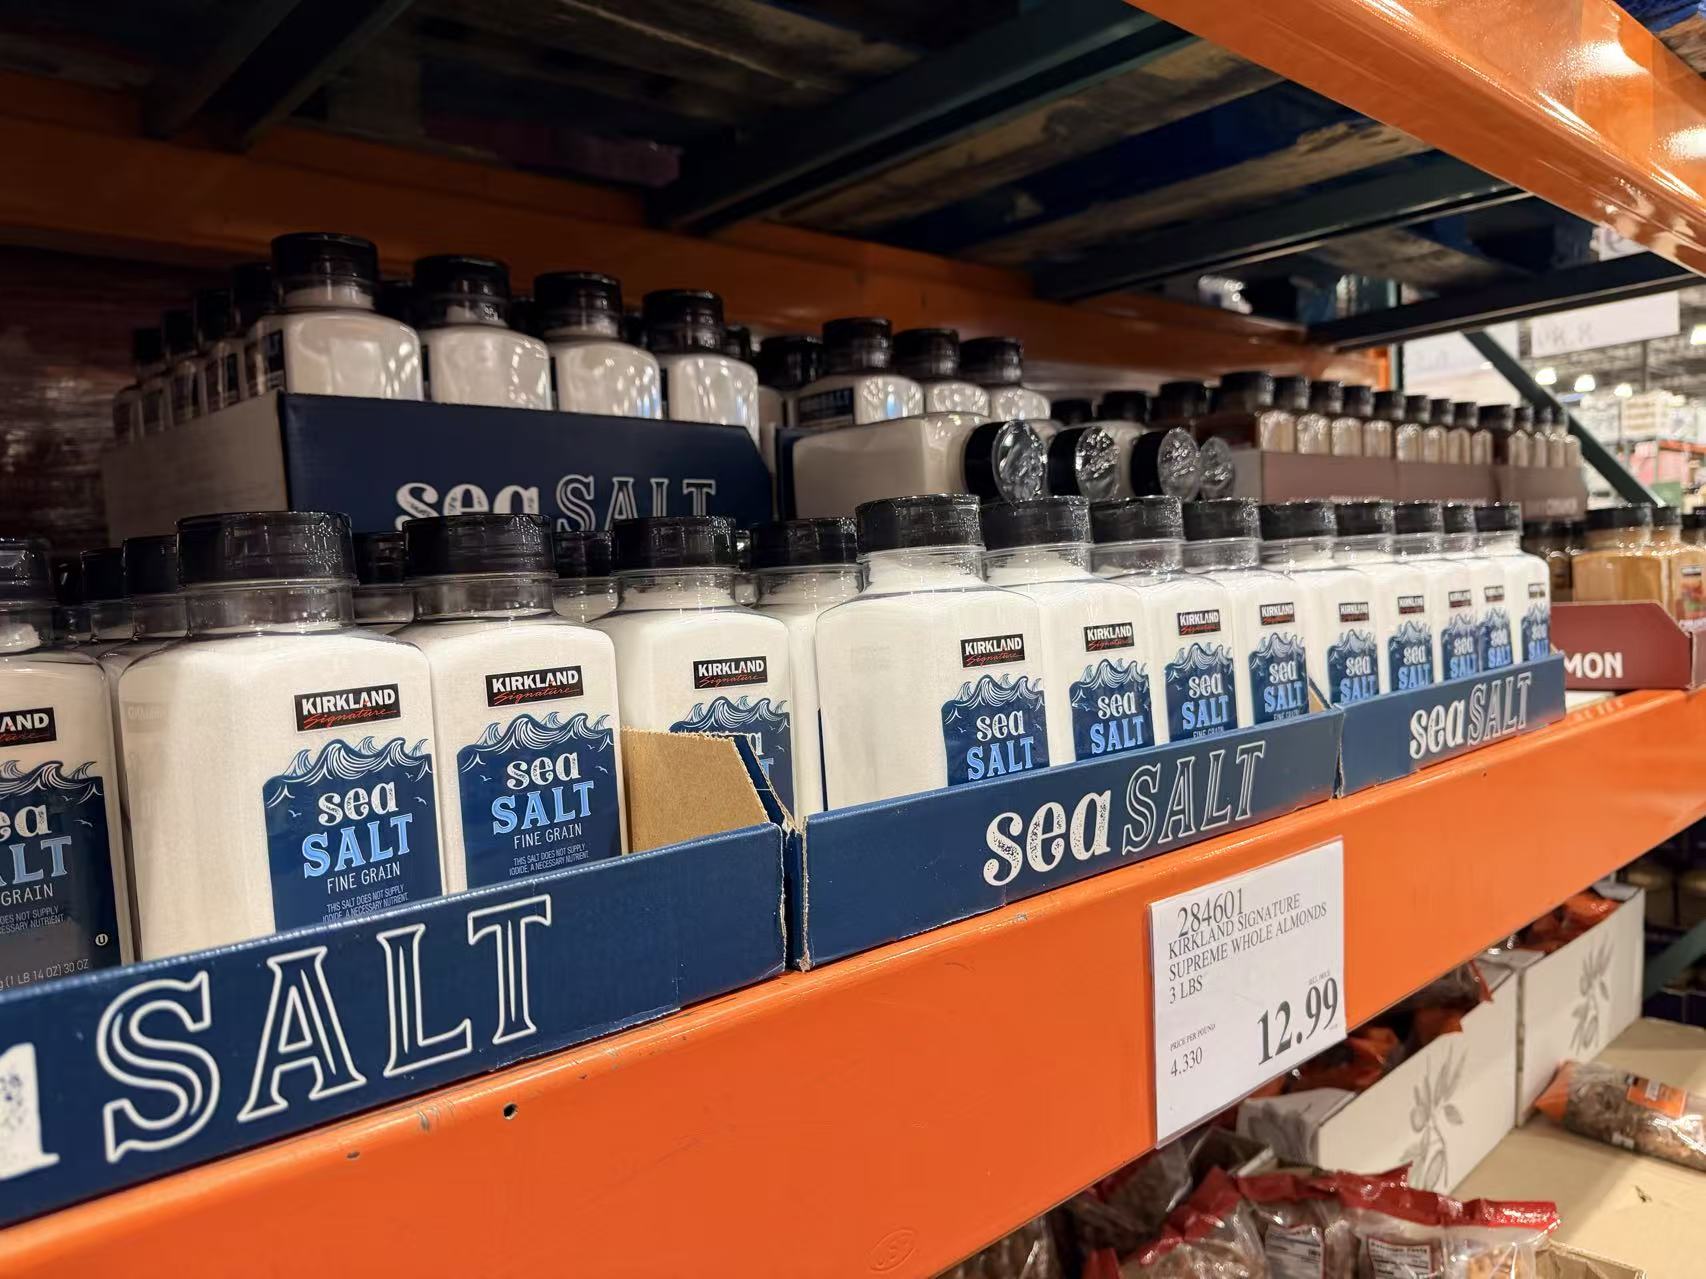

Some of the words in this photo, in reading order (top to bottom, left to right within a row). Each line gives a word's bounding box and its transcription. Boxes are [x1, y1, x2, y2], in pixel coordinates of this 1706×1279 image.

[1179, 611, 1220, 626] KIRKLAND
[1261, 603, 1294, 617] KIRKLAND
[1086, 624, 1133, 641] KIRKLAND
[963, 651, 1023, 667] Signature
[964, 636, 1023, 656] KIRKLAND
[1403, 645, 1427, 666] sea
[1487, 645, 1511, 669] SALT
[697, 659, 764, 677] KIRKLAND
[1269, 660, 1299, 684] sea
[1345, 655, 1371, 677] sea
[1398, 664, 1431, 690] SALT
[1450, 654, 1477, 680] SALT
[492, 669, 580, 693] KIRKLAND
[697, 673, 765, 689] Signature
[1188, 673, 1223, 698] sea
[1339, 674, 1377, 705] SALT
[301, 688, 396, 715] KIRKLAND
[493, 687, 581, 705] Signature
[1097, 692, 1137, 720] sea
[1263, 681, 1303, 714] SALT
[303, 709, 397, 729] Signature
[1181, 695, 1229, 730] SALT
[1410, 698, 1464, 760] sea
[1467, 671, 1532, 747] SALT
[976, 712, 1024, 743] sea
[1090, 715, 1145, 755] SALT
[506, 751, 581, 790] sea
[966, 736, 1034, 781] SALT
[317, 781, 399, 827] sea
[491, 780, 595, 835] SALT
[983, 789, 1112, 887] sea
[1122, 741, 1266, 856] SALT
[301, 812, 413, 879] SALT
[514, 831, 542, 849] FINE
[545, 822, 582, 843] GRAIN
[513, 856, 527, 866] THIS
[527, 853, 540, 863] SALT
[540, 849, 556, 860] DOES
[556, 847, 567, 857] NOT
[567, 843, 586, 854] SUPPLY
[535, 857, 565, 870] NECESSARY
[327, 872, 357, 895] FINE
[361, 861, 401, 885] GRAIN
[0, 883, 54, 906] GRAIN
[327, 901, 341, 913] THIS
[341, 896, 356, 910] SALT
[356, 892, 372, 905] DOES
[372, 889, 384, 900] NOT
[384, 884, 405, 897] SUPPLY
[15, 910, 30, 922] NOT
[32, 904, 59, 919] SUPPLY
[350, 901, 383, 916] NECESSARY
[1177, 887, 1244, 939] 284601
[0, 921, 29, 935] ESSARY
[1168, 920, 1235, 960] KIRKLAND
[1237, 892, 1301, 933] SIGNATURE
[1169, 942, 1228, 982] SUPREME
[1231, 924, 1272, 954] WHOLE
[1275, 902, 1328, 935] ALMONDS
[18, 972, 31, 984] LB
[33, 970, 44, 980] 14
[64, 962, 75, 973] 30
[77, 958, 89, 970] OZ
[1169, 986, 1177, 1004] 3
[1180, 974, 1203, 1000] LBS
[96, 895, 552, 1164] SALT
[1257, 977, 1338, 1066] 12.99
[1186, 1032, 1197, 1043] PER
[1170, 1046, 1203, 1077] 4.330
